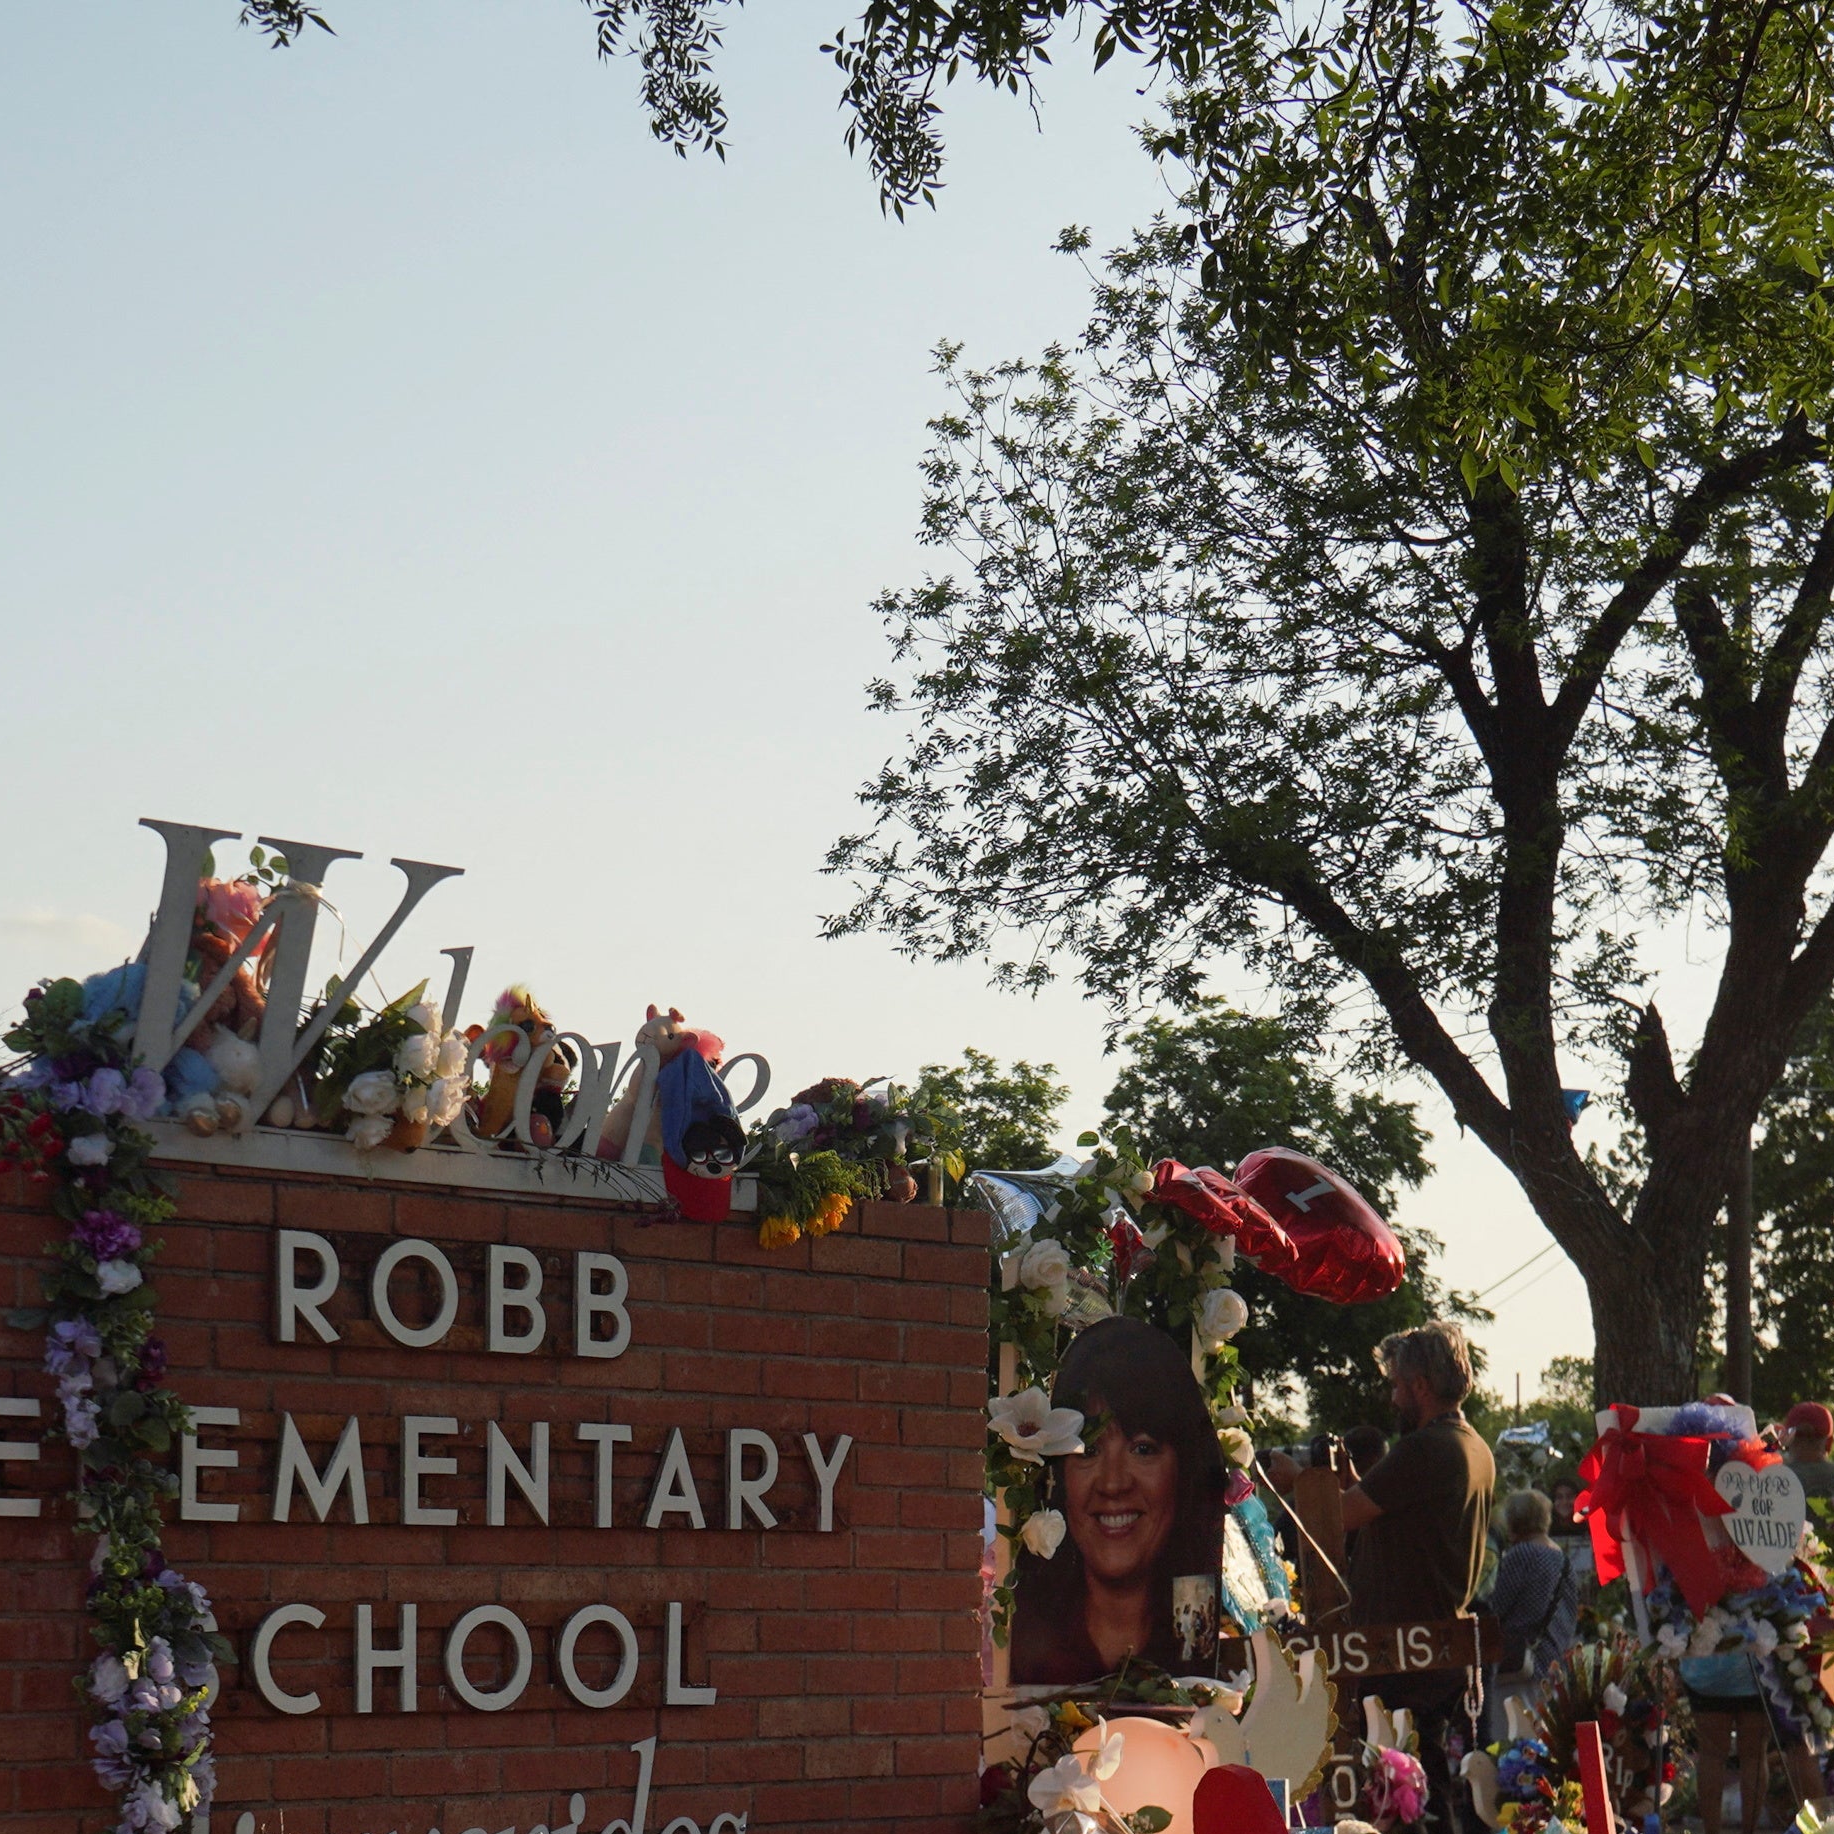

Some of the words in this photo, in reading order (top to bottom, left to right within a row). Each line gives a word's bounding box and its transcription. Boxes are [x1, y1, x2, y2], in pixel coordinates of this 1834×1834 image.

[275, 1228, 633, 1360] ROBB
[1732, 1518, 1797, 1549] UVALDE
[197, 1602, 718, 1716] CHOOL
[1396, 1625, 1434, 1671] IS
